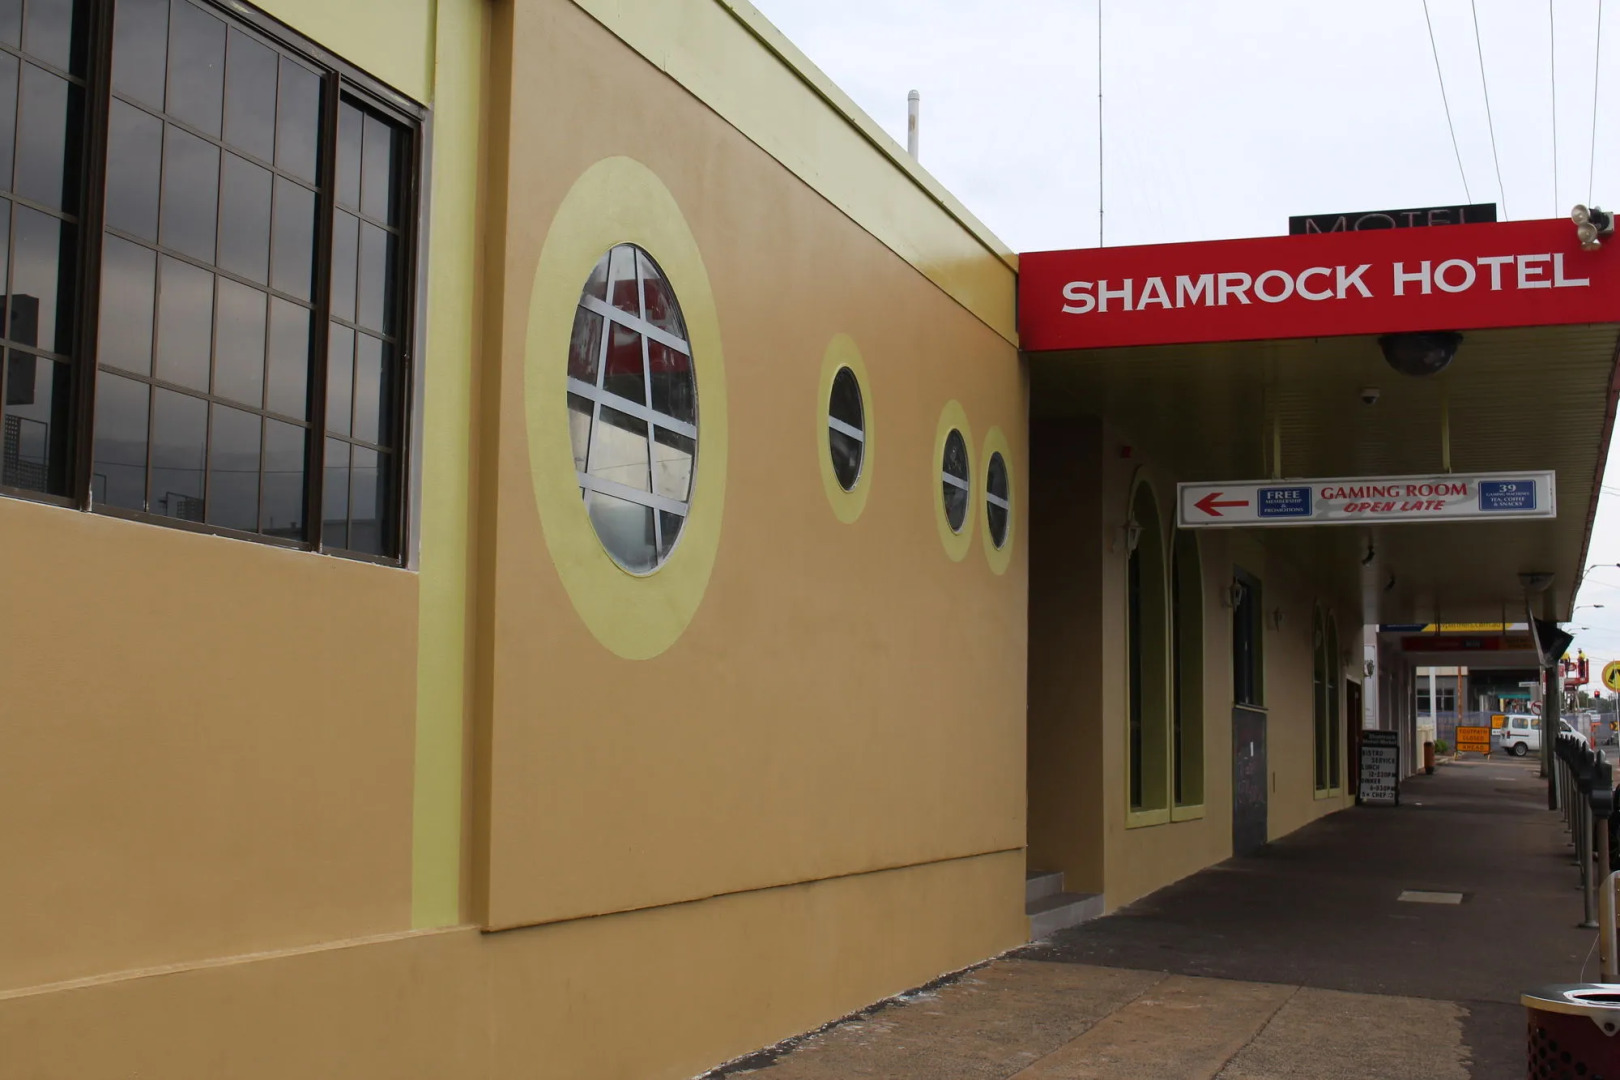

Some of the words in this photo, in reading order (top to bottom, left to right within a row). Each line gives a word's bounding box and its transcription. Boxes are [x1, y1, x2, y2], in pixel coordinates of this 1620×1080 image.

[1061, 263, 1374, 315] SHAMROCK
[1392, 251, 1591, 297] HOTEL
[1267, 491, 1301, 499] FREE
[1320, 486, 1400, 499] GAMING
[1406, 482, 1468, 497] ROOM
[1499, 484, 1516, 492] 39
[1343, 501, 1396, 513] OPEN
[1400, 499, 1446, 512] LATE
